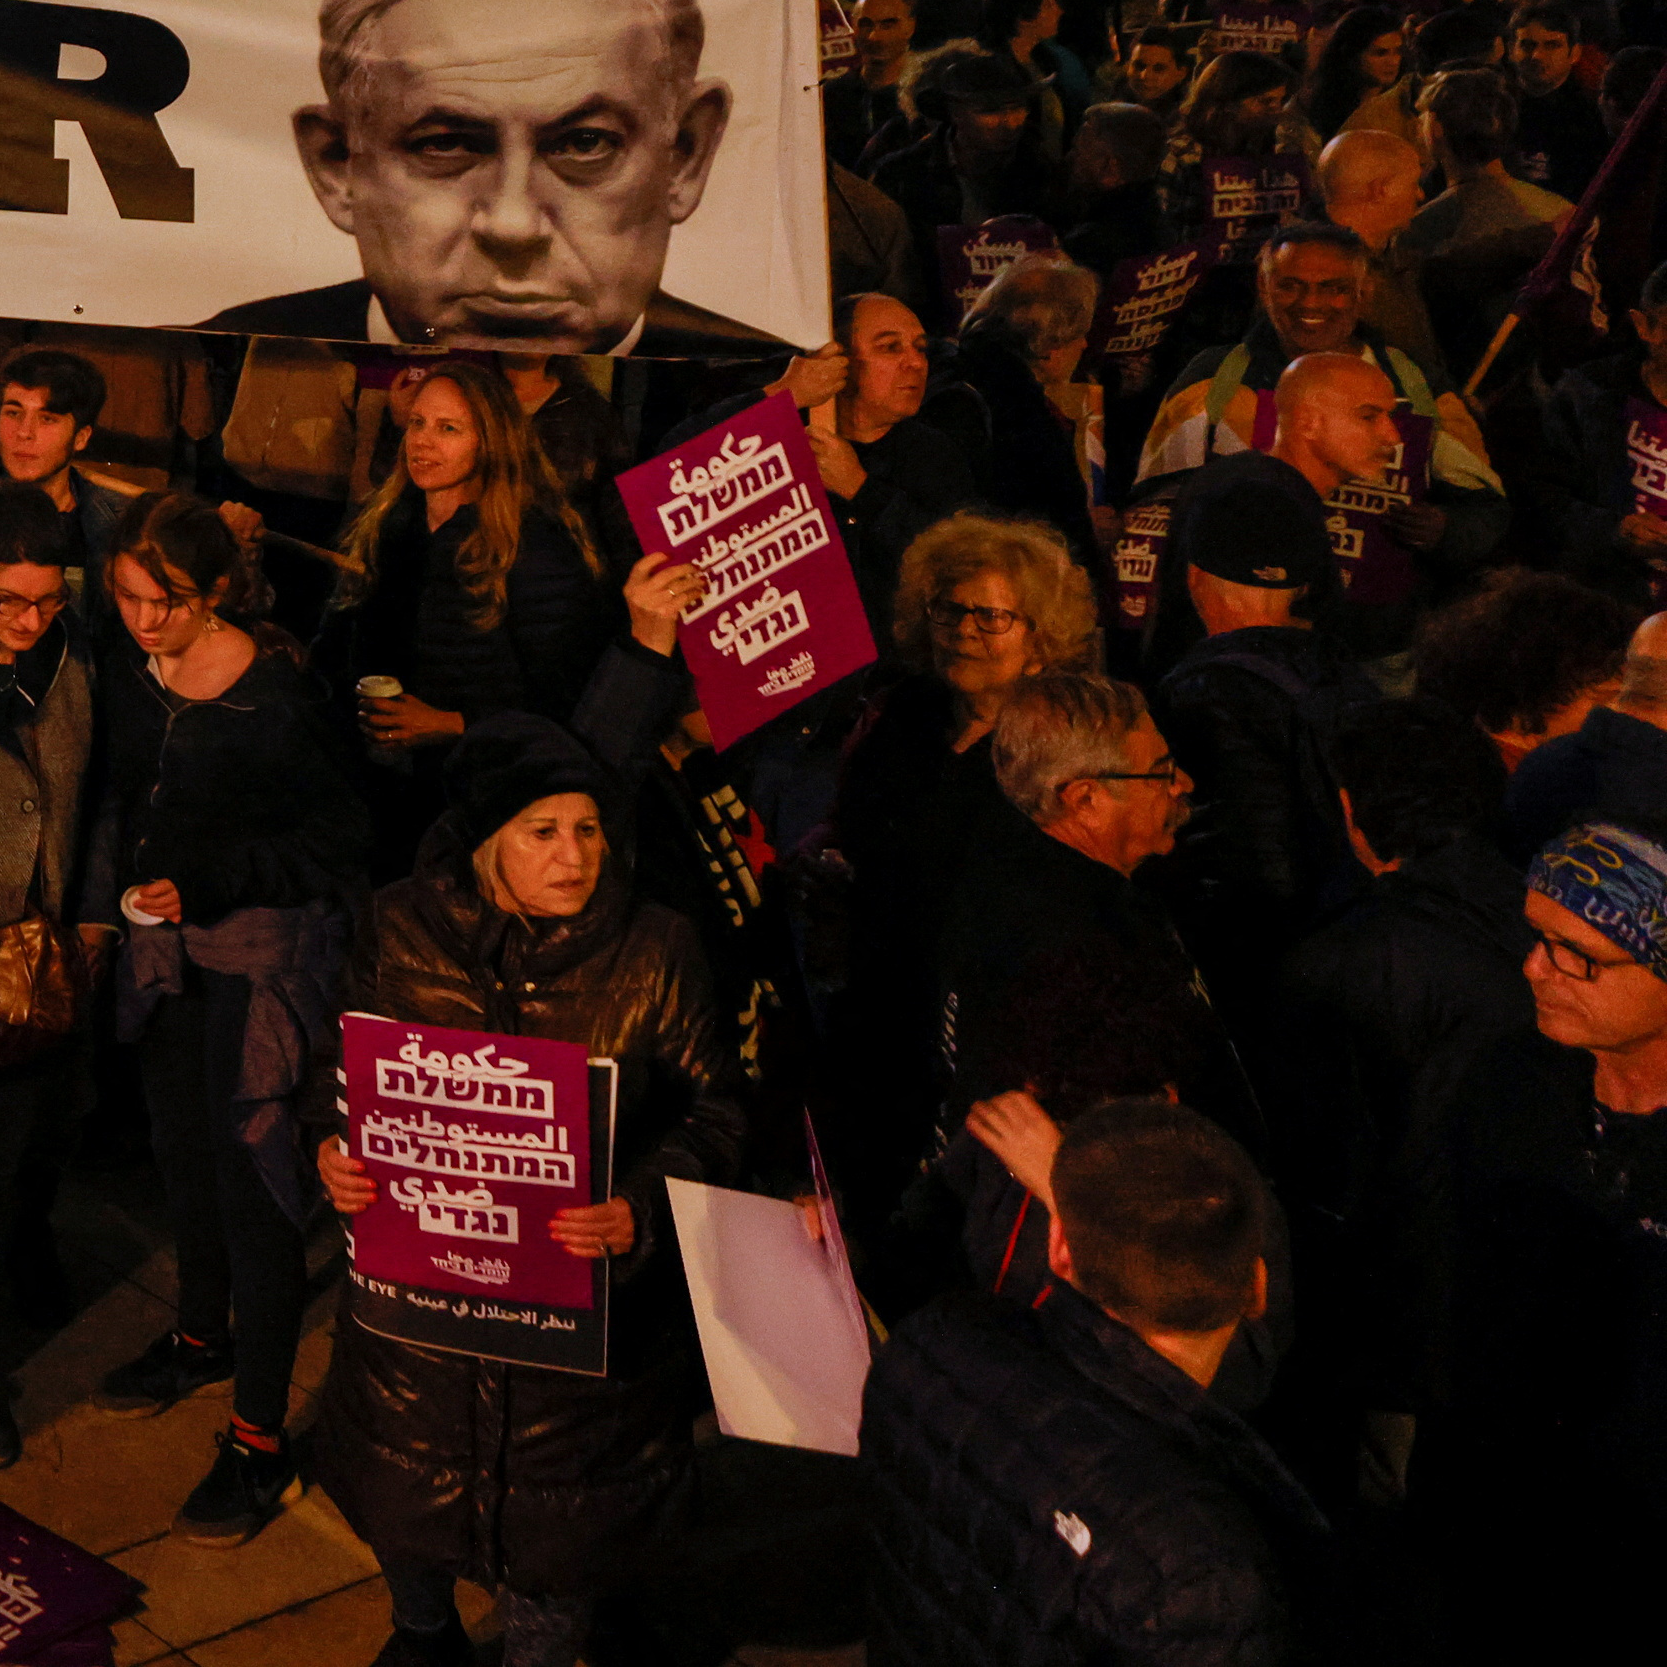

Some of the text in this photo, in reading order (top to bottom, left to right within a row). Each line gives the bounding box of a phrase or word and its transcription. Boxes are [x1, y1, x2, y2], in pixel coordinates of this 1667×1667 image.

[669, 431, 763, 495] حكومة
[667, 452, 788, 537] ממשלת
[691, 482, 814, 569] المستوطن
[683, 516, 825, 619] המתנחל
[709, 579, 783, 656] ضدي
[737, 601, 801, 646] נגדי
[398, 1032, 529, 1081] حكومة
[383, 1066, 546, 1112] ממשלת
[365, 1109, 568, 1152] المستوطنين
[367, 1131, 571, 1184] המתנחלים
[389, 1176, 494, 1213] ضدي
[428, 1203, 510, 1238] נגדי
[368, 1277, 397, 1300] EYE
[452, 1299, 469, 1319] في
[472, 1302, 538, 1327] الاحتلال
